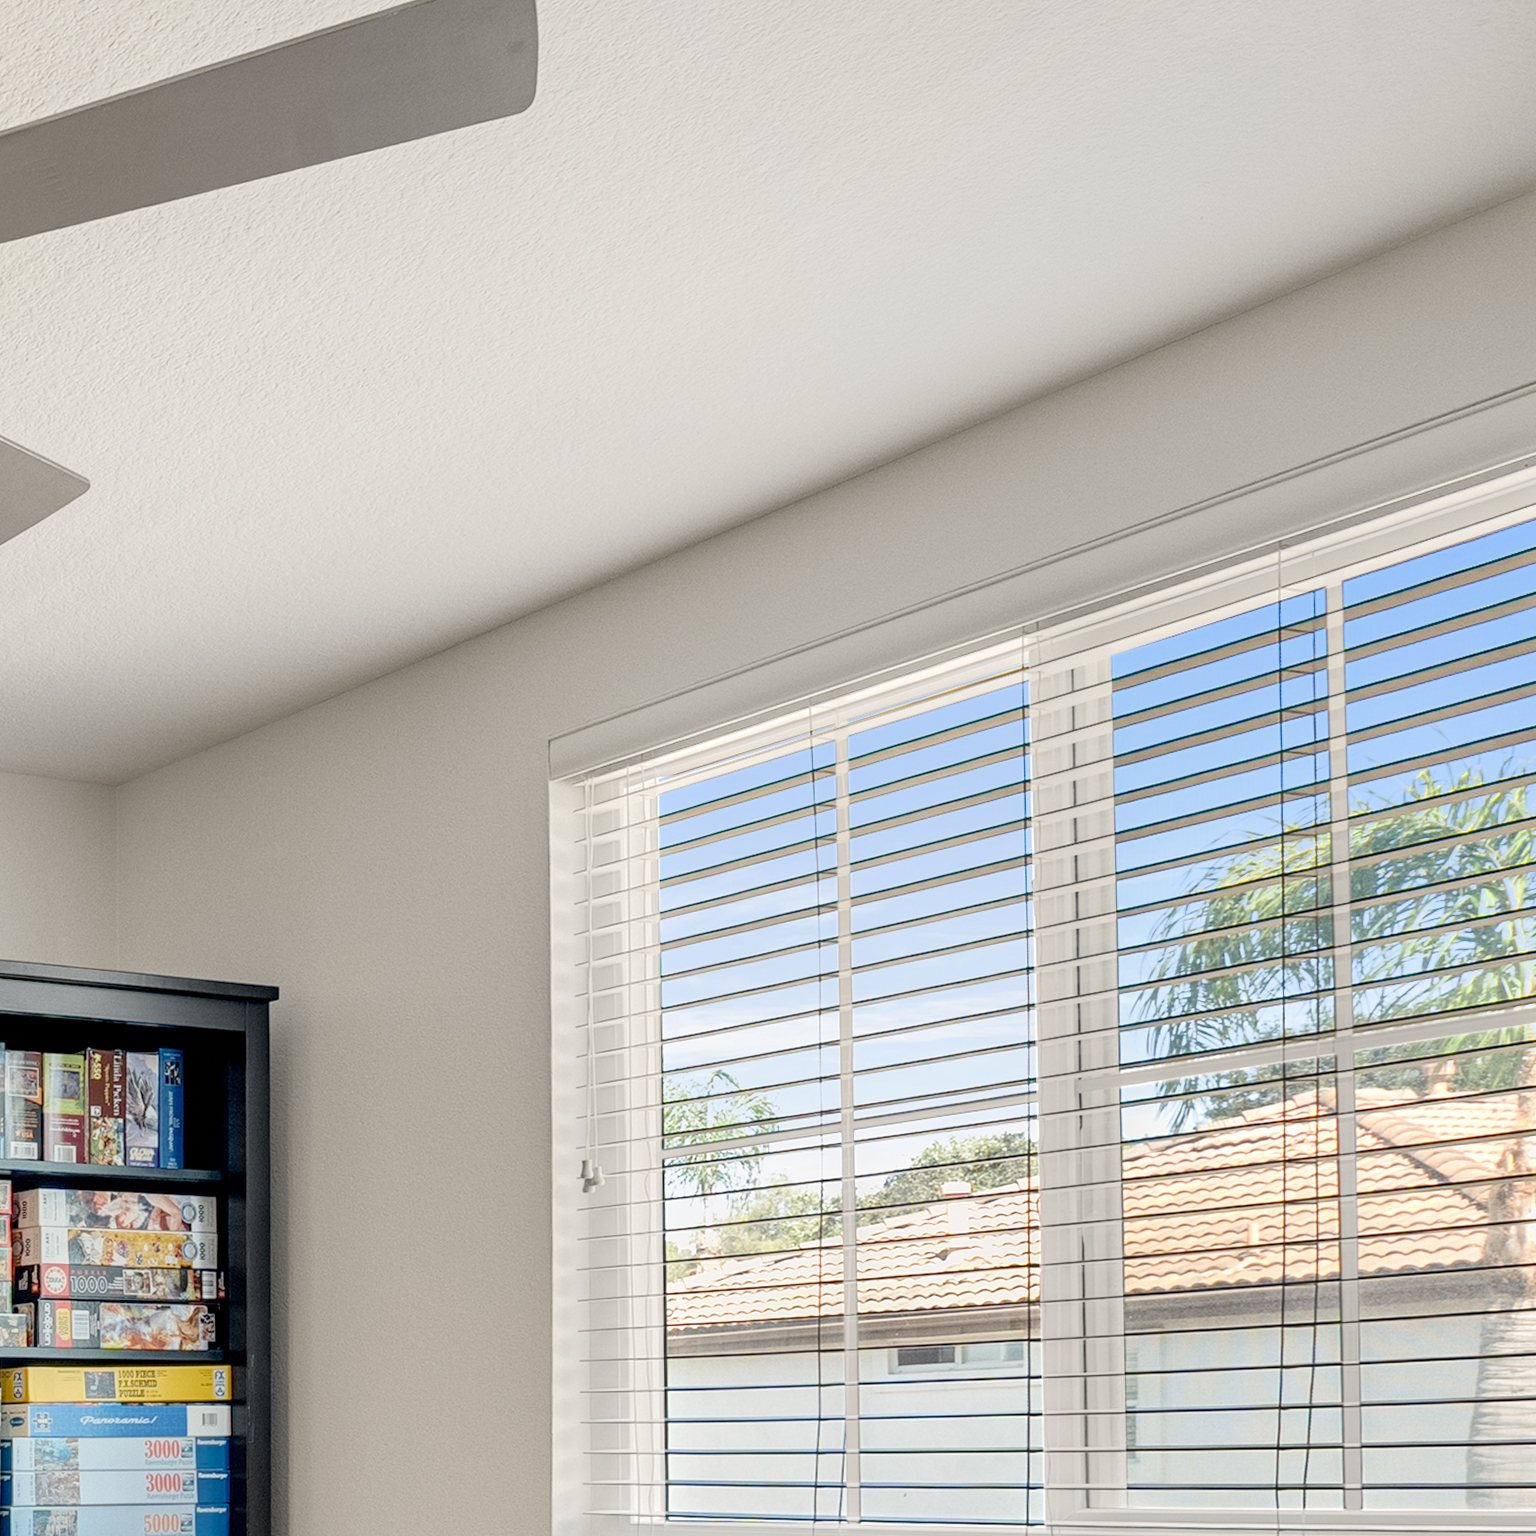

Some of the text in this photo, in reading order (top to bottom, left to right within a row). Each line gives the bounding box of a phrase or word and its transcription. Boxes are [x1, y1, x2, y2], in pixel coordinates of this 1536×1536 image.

[113, 1086, 123, 1116] Picken
[70, 1276, 108, 1294] 1000
[80, 1416, 158, 1426] Panoramic!
[144, 1440, 180, 1458] 3000
[144, 1514, 179, 1532] 5000
